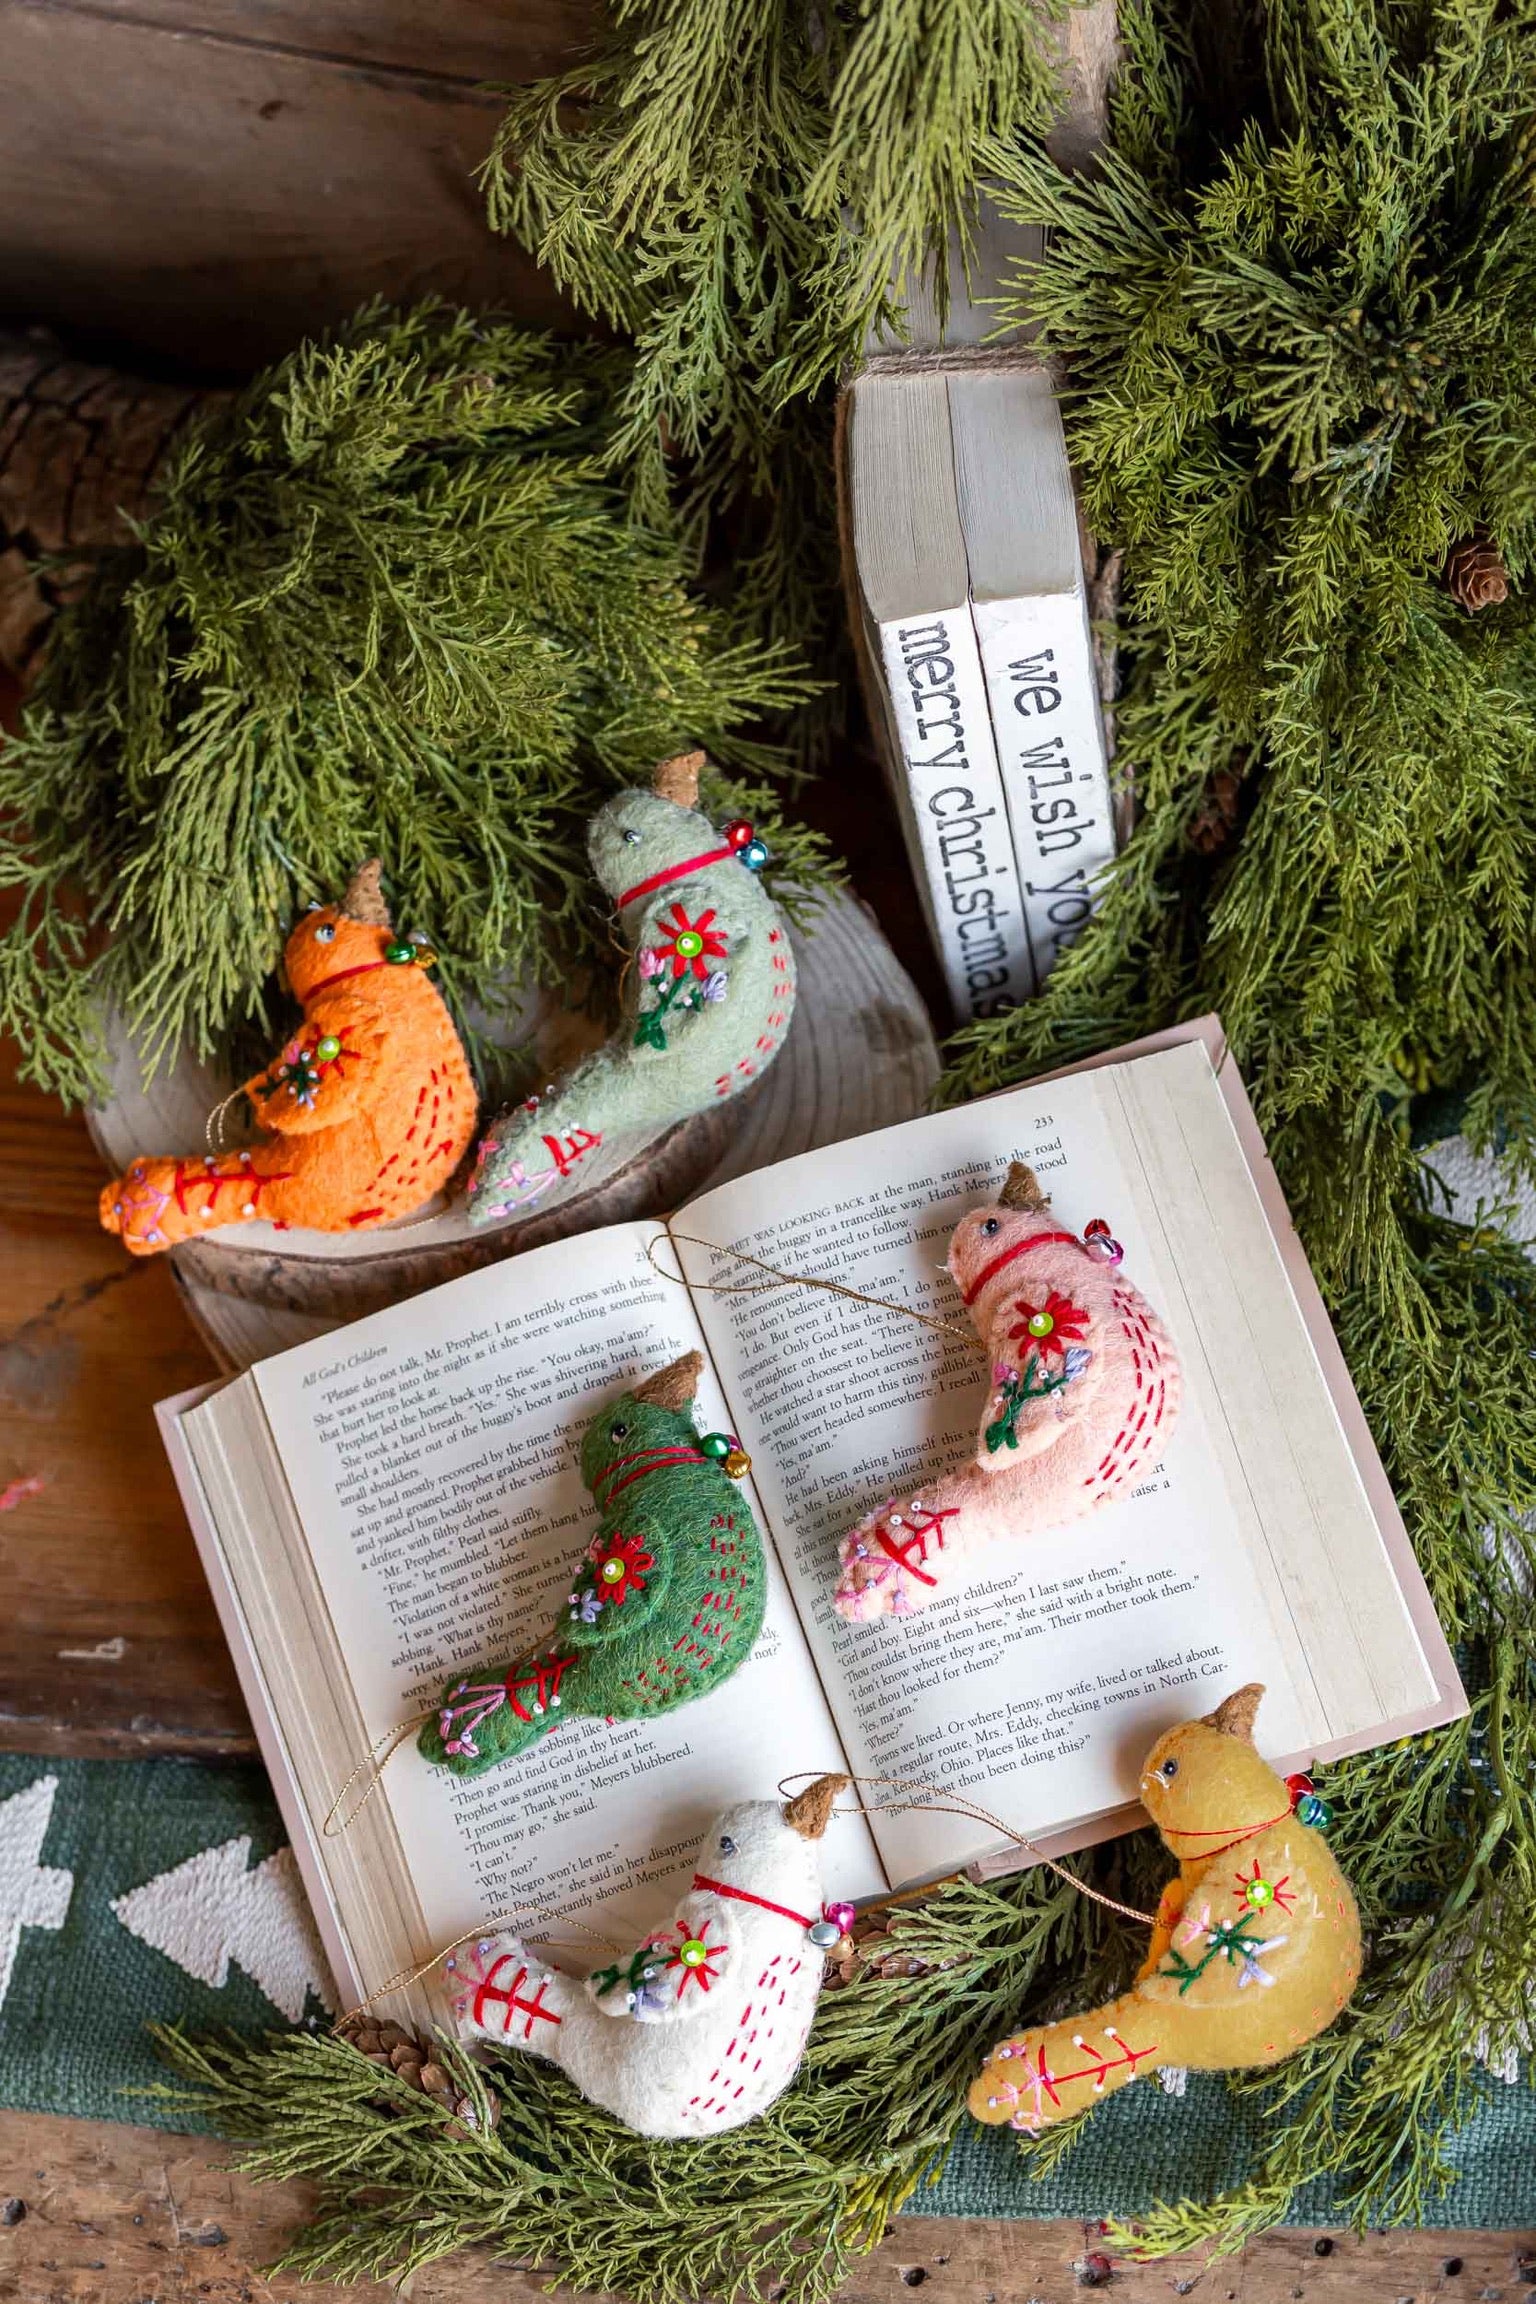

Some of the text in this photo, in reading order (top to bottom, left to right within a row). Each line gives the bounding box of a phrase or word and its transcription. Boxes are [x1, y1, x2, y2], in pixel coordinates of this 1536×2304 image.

[898, 619, 970, 772] merry
[1007, 648, 1062, 717] we
[1019, 736, 1095, 857] wish
[1034, 1115, 1054, 1129] 233
[753, 1136, 1062, 1241] WAS LOOKING BACK at the man, standing in the road
[759, 1348, 942, 1425] He watched a star shoot across the
[386, 1598, 409, 1613] The
[411, 1589, 435, 1605] man
[435, 1575, 469, 1594] began
[469, 1569, 483, 1580] to
[859, 1639, 878, 1659] and
[878, 1634, 902, 1650] boy.
[902, 1620, 935, 1639] Eight
[938, 1608, 961, 1628] and
[1028, 1586, 1035, 1599] I
[1037, 1583, 1059, 1596] last
[1062, 1576, 1084, 1590] saw
[870, 1649, 907, 1672] couldst
[908, 1638, 941, 1656] bring
[942, 1627, 974, 1644] them
[1015, 1607, 1036, 1621] she
[1039, 1596, 1064, 1614] said
[1065, 1588, 1093, 1606] with
[1096, 1588, 1104, 1598] a
[1104, 1575, 1143, 1595] bright
[1145, 1569, 1177, 1584] note.
[928, 1594, 960, 1612] many
[857, 1677, 880, 1698] don’t
[879, 1667, 910, 1687] know
[911, 1654, 947, 1673] where
[949, 1645, 974, 1660] they
[977, 1638, 1001, 1651] are,
[1002, 1624, 1046, 1643] ma’am.
[1047, 1611, 1082, 1629] Their
[1084, 1599, 1127, 1619] mother
[1130, 1587, 1159, 1606] took
[877, 1690, 901, 1707] thou
[901, 1670, 941, 1697] looked
[942, 1667, 960, 1681] for
[898, 1662, 1228, 1774] regular route, Mrs. Eddy, checking towns in North Car-
[899, 1741, 915, 1753] we
[915, 1725, 946, 1747] lived.
[947, 1720, 965, 1734] Or
[967, 1709, 1004, 1728] where
[1005, 1698, 1043, 1719] Jenny,
[1044, 1691, 1063, 1704] my
[1065, 1680, 1096, 1697] wife,
[1096, 1668, 1127, 1688] lived
[1129, 1668, 1143, 1679] or
[1145, 1652, 1183, 1674] talked
[1185, 1645, 1224, 1663] about.
[453, 1741, 657, 1825] Prophet was staring in disbelief at her.
[473, 1813, 520, 1839] promise.
[520, 1794, 557, 1817] Thank
[589, 1768, 630, 1791] Meyers
[630, 1742, 694, 1774] blubbered.
[486, 1783, 500, 1798] go
[502, 1769, 523, 1789] and
[524, 1759, 548, 1779] find
[548, 1749, 574, 1769] God
[575, 1747, 588, 1759] in
[589, 1739, 607, 1754] thy
[940, 1756, 974, 1774] Ohio.
[975, 1743, 1014, 1762] Places
[1015, 1734, 1039, 1749] like
[957, 1771, 986, 1787] thou
[986, 1761, 1017, 1777] been
[1020, 1749, 1056, 1766] doing
[502, 1828, 524, 1844] may
[552, 1809, 571, 1824] she
[572, 1796, 598, 1816] said.
[509, 1876, 545, 1896] Negro
[546, 1861, 578, 1881] won’t
[577, 1857, 594, 1870] let
